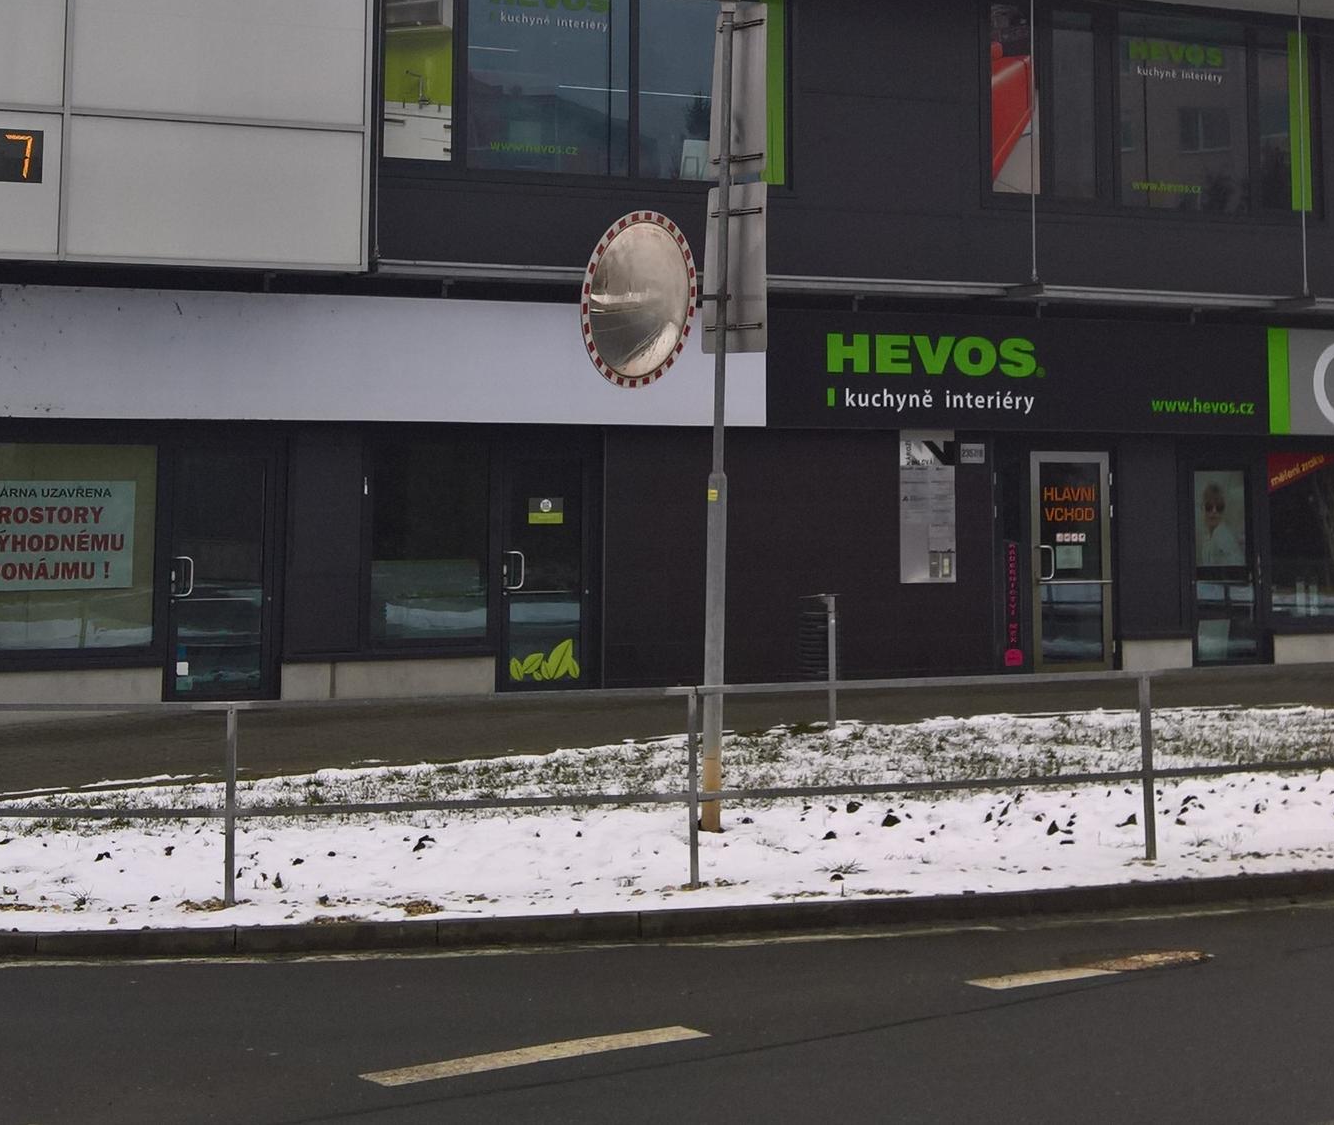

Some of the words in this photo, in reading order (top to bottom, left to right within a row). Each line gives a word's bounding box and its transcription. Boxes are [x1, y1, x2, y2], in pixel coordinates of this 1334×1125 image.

[826, 333, 1037, 378] HEVOS
[845, 388, 933, 412] kuchyně
[945, 390, 1034, 414] interiéry
[1151, 397, 1255, 415] www.hevos.cz
[41, 485, 112, 498] UZAVŘENA
[1043, 483, 1096, 502] HLAVNÍ
[1045, 507, 1095, 522] VCHOD
